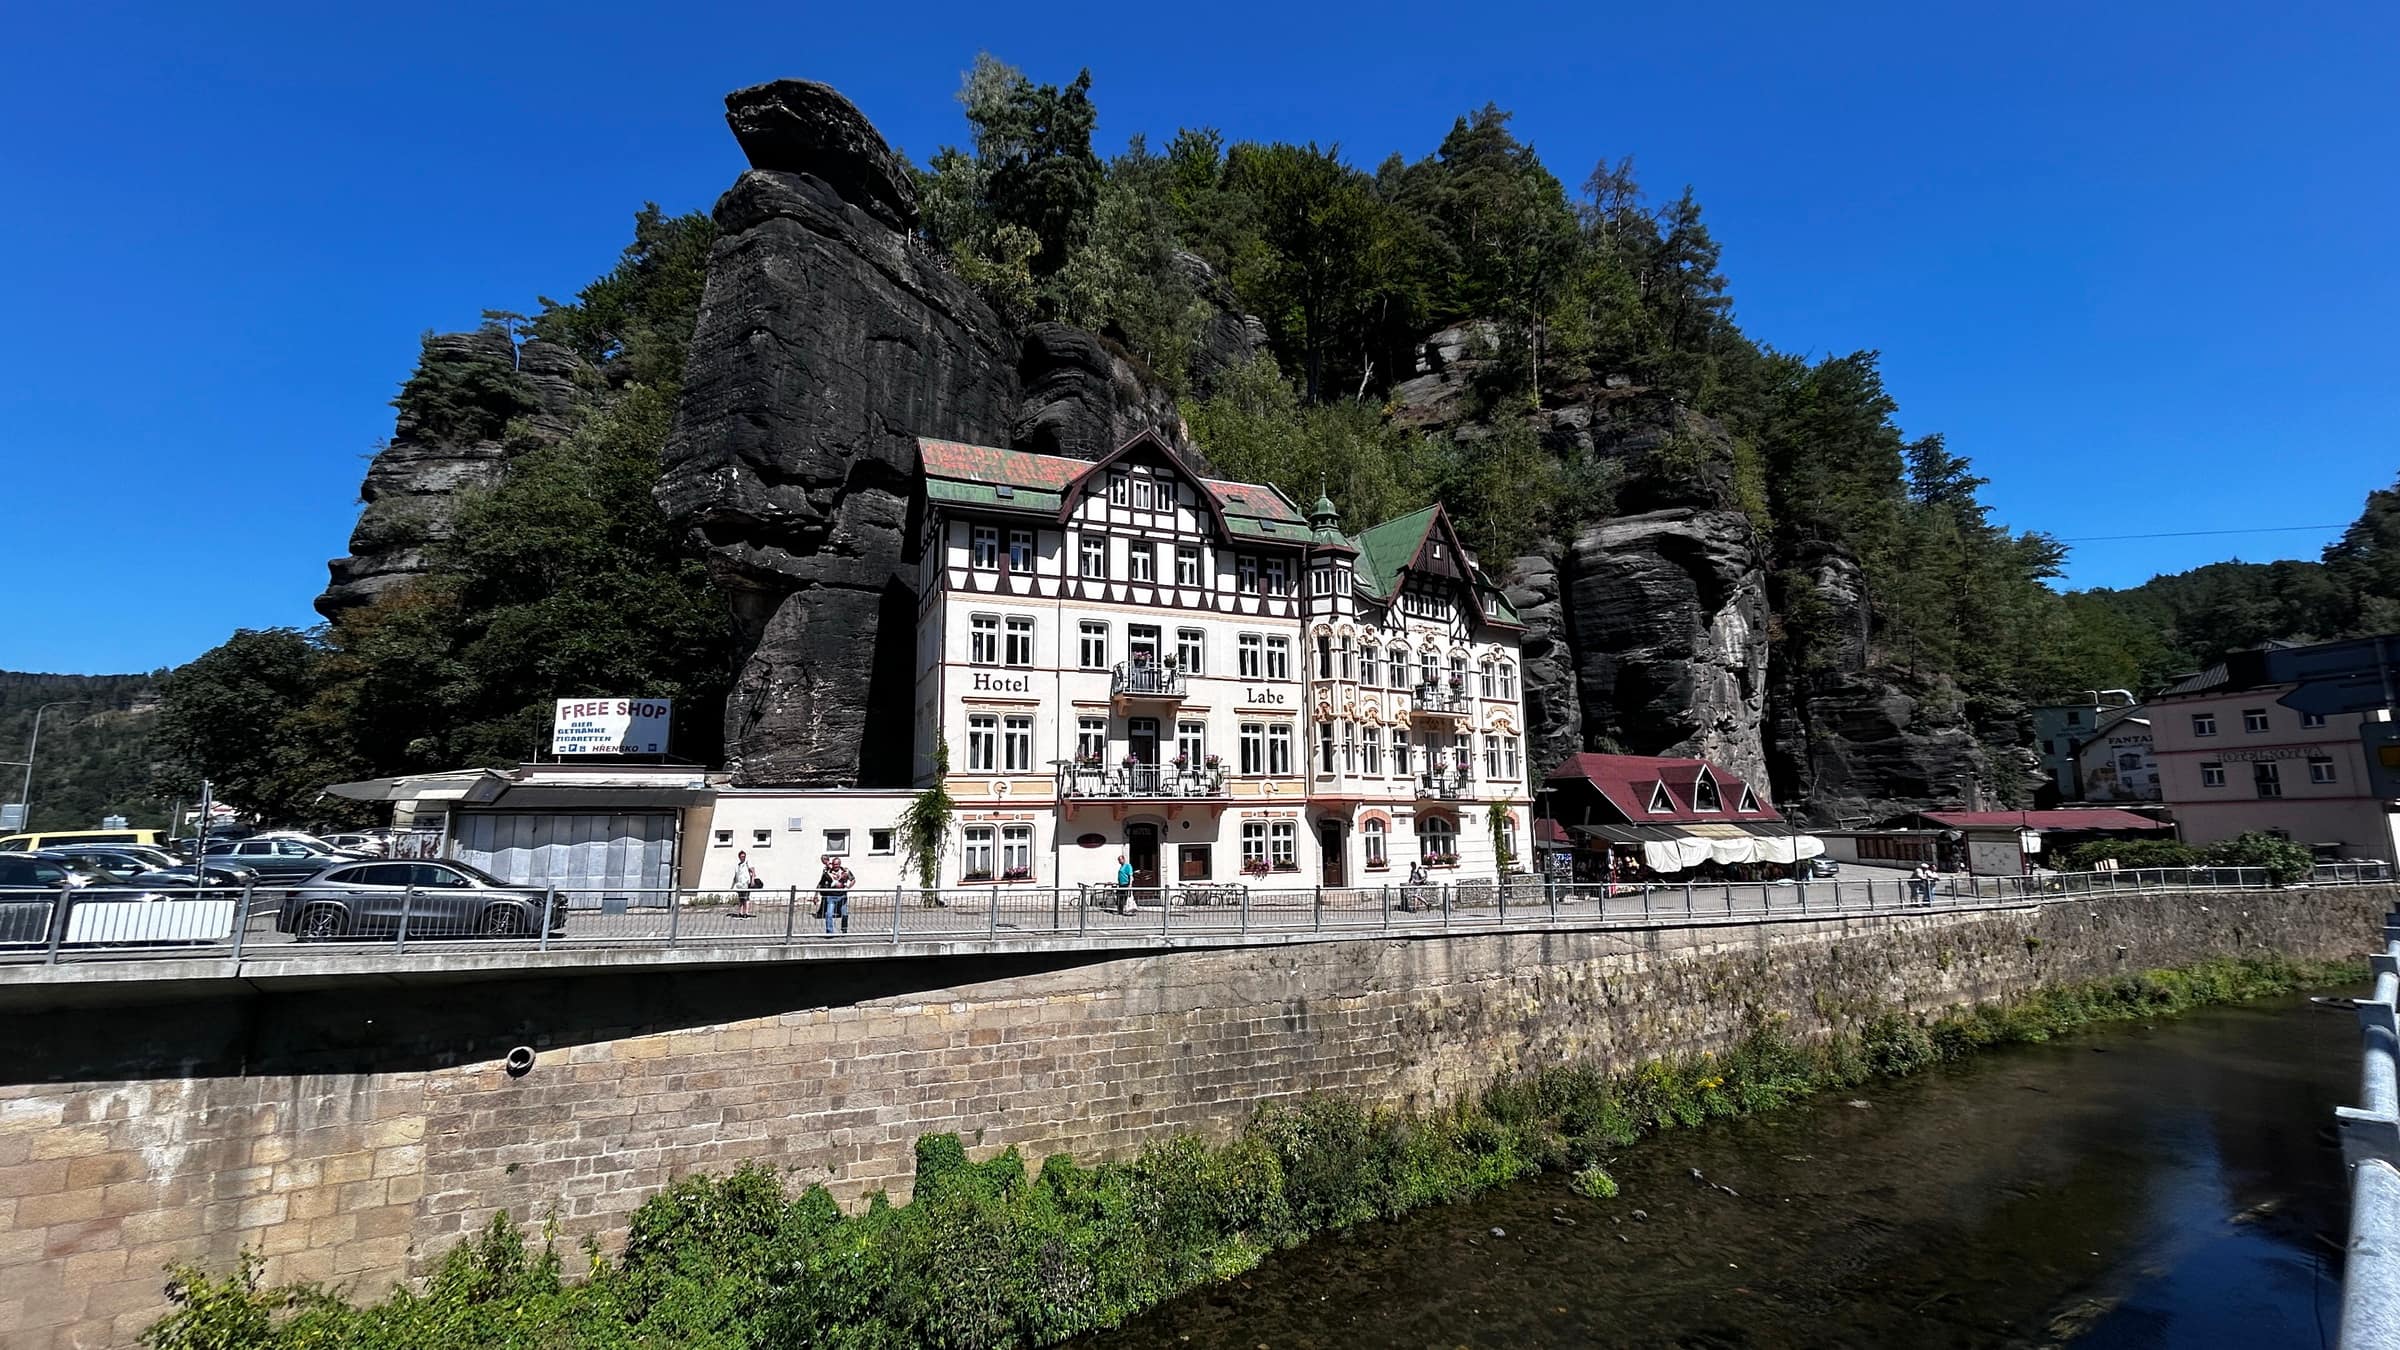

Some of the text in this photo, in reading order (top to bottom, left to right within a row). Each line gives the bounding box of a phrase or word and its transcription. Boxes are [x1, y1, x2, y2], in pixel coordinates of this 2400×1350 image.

[973, 673, 1029, 692] Hotel
[1246, 687, 1284, 704] Labe
[562, 701, 667, 720] FREE SHOP
